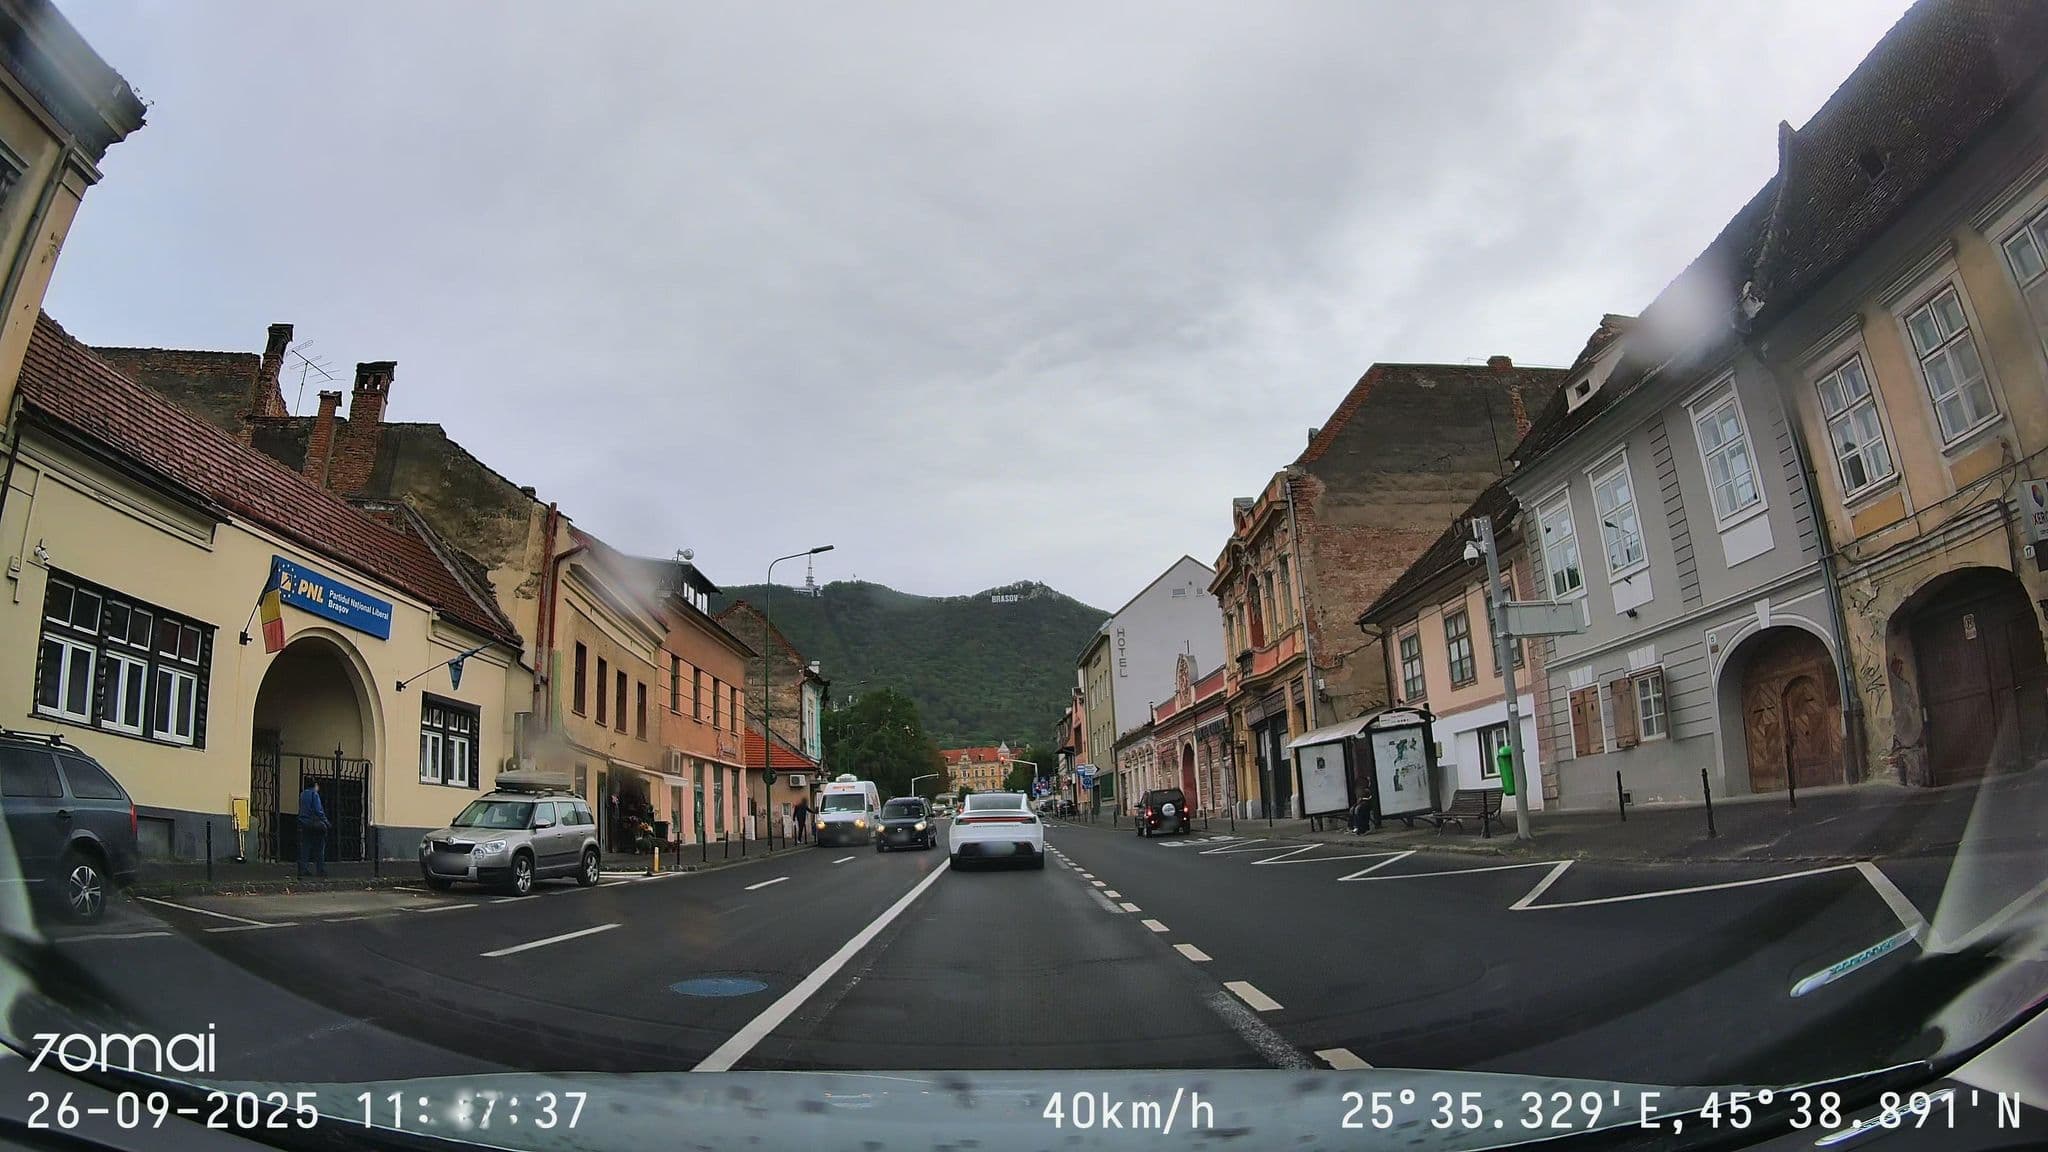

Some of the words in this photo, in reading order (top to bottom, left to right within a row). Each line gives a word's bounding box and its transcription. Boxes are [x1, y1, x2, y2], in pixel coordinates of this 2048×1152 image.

[298, 579, 324, 604] PNL
[991, 594, 1018, 603] BRASOV
[328, 599, 350, 615] Brașov
[329, 590, 350, 605] Partidul
[372, 606, 389, 620] Liberal
[1116, 628, 1128, 678] HOTEL
